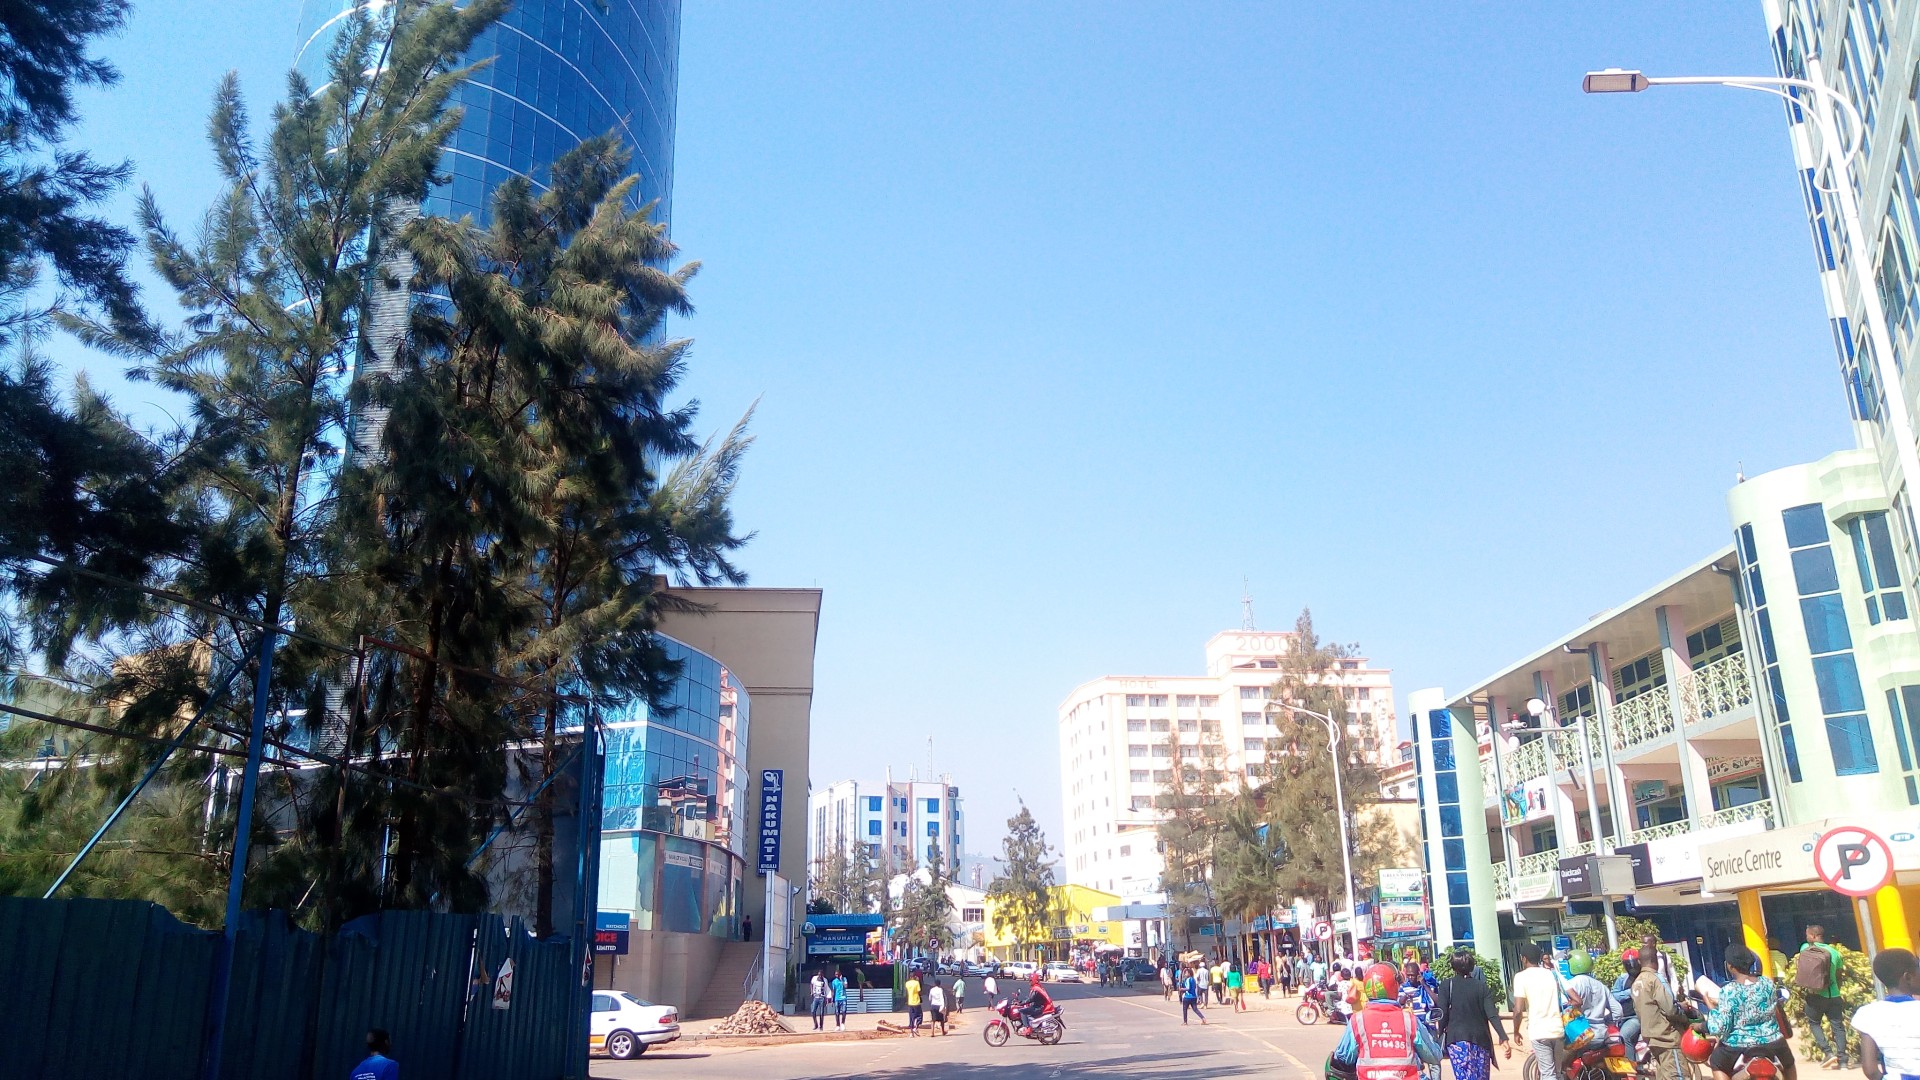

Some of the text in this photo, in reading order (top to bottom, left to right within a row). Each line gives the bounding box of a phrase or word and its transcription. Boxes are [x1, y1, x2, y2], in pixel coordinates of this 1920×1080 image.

[1119, 680, 1160, 689] HOTEL
[762, 795, 779, 862] NAKUMATT
[1707, 849, 1782, 879] Service Centre
[1837, 843, 1871, 880] P
